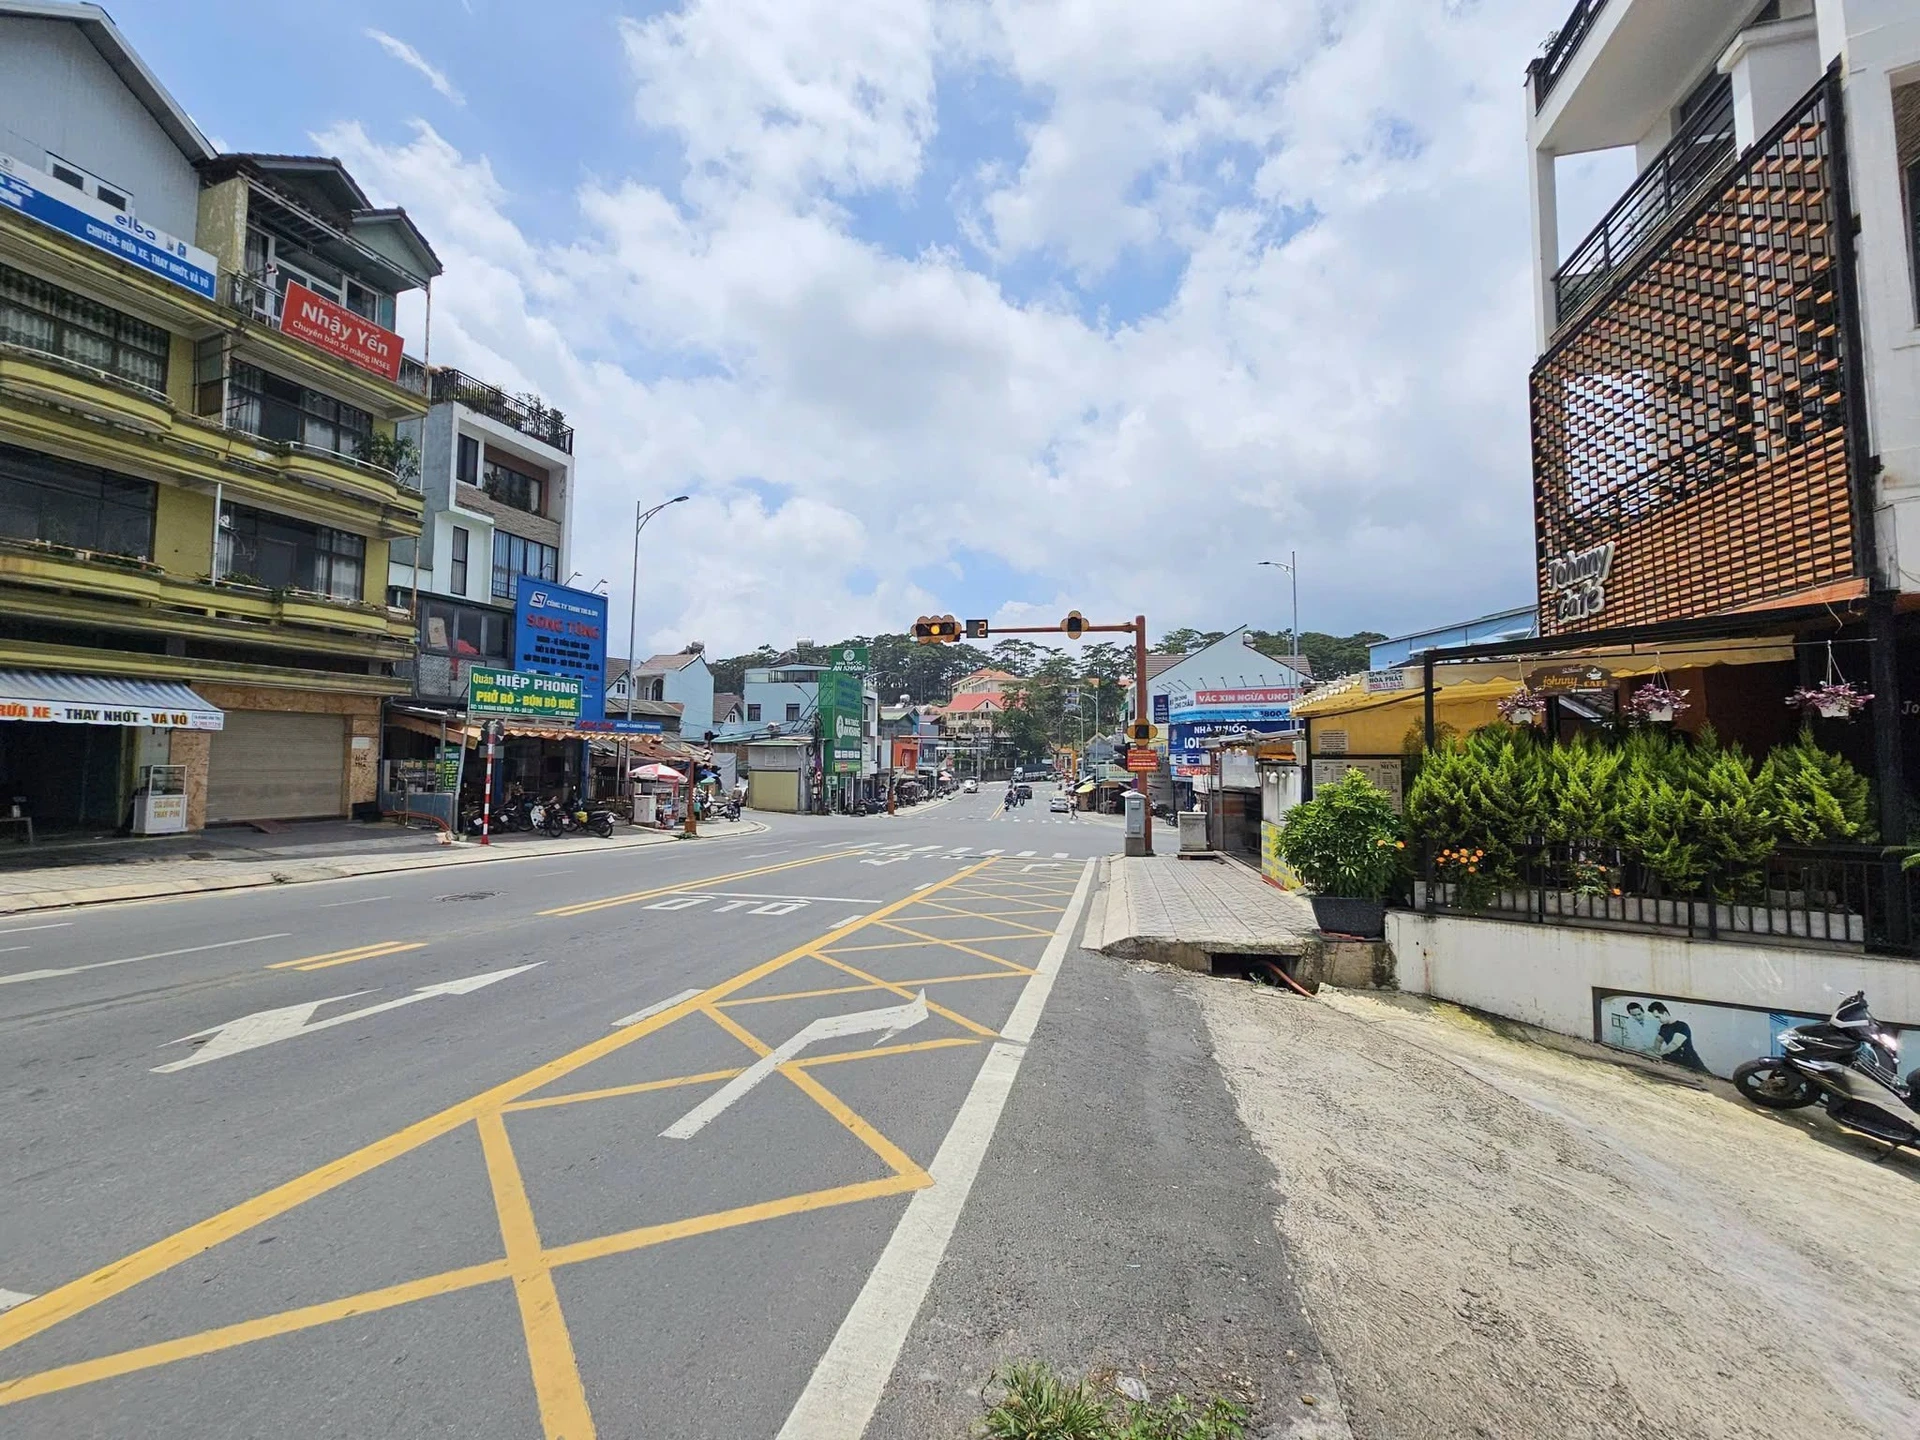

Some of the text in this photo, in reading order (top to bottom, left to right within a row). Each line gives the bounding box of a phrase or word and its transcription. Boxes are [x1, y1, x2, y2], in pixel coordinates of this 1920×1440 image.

[115, 214, 156, 240] elba
[301, 301, 352, 341] Nhậy
[356, 327, 389, 357] Yến
[292, 320, 323, 339] Chuyên
[324, 334, 339, 347] bán
[349, 347, 371, 363] măng
[1548, 541, 1616, 593] Johnny
[1556, 580, 1605, 624] Café
[977, 621, 987, 637] 2
[473, 673, 494, 685] Quán
[495, 674, 530, 690] HIỆP
[533, 679, 579, 694] PHONG
[476, 690, 499, 702] PHỞ
[500, 692, 514, 705] BÒ
[544, 696, 557, 708] BÒ
[558, 698, 576, 709] HUẾ
[1267, 693, 1288, 701] UNG
[32, 706, 51, 718] XE
[65, 708, 100, 720] THAY
[104, 710, 139, 722] NHỚT
[152, 712, 168, 724] VÁ
